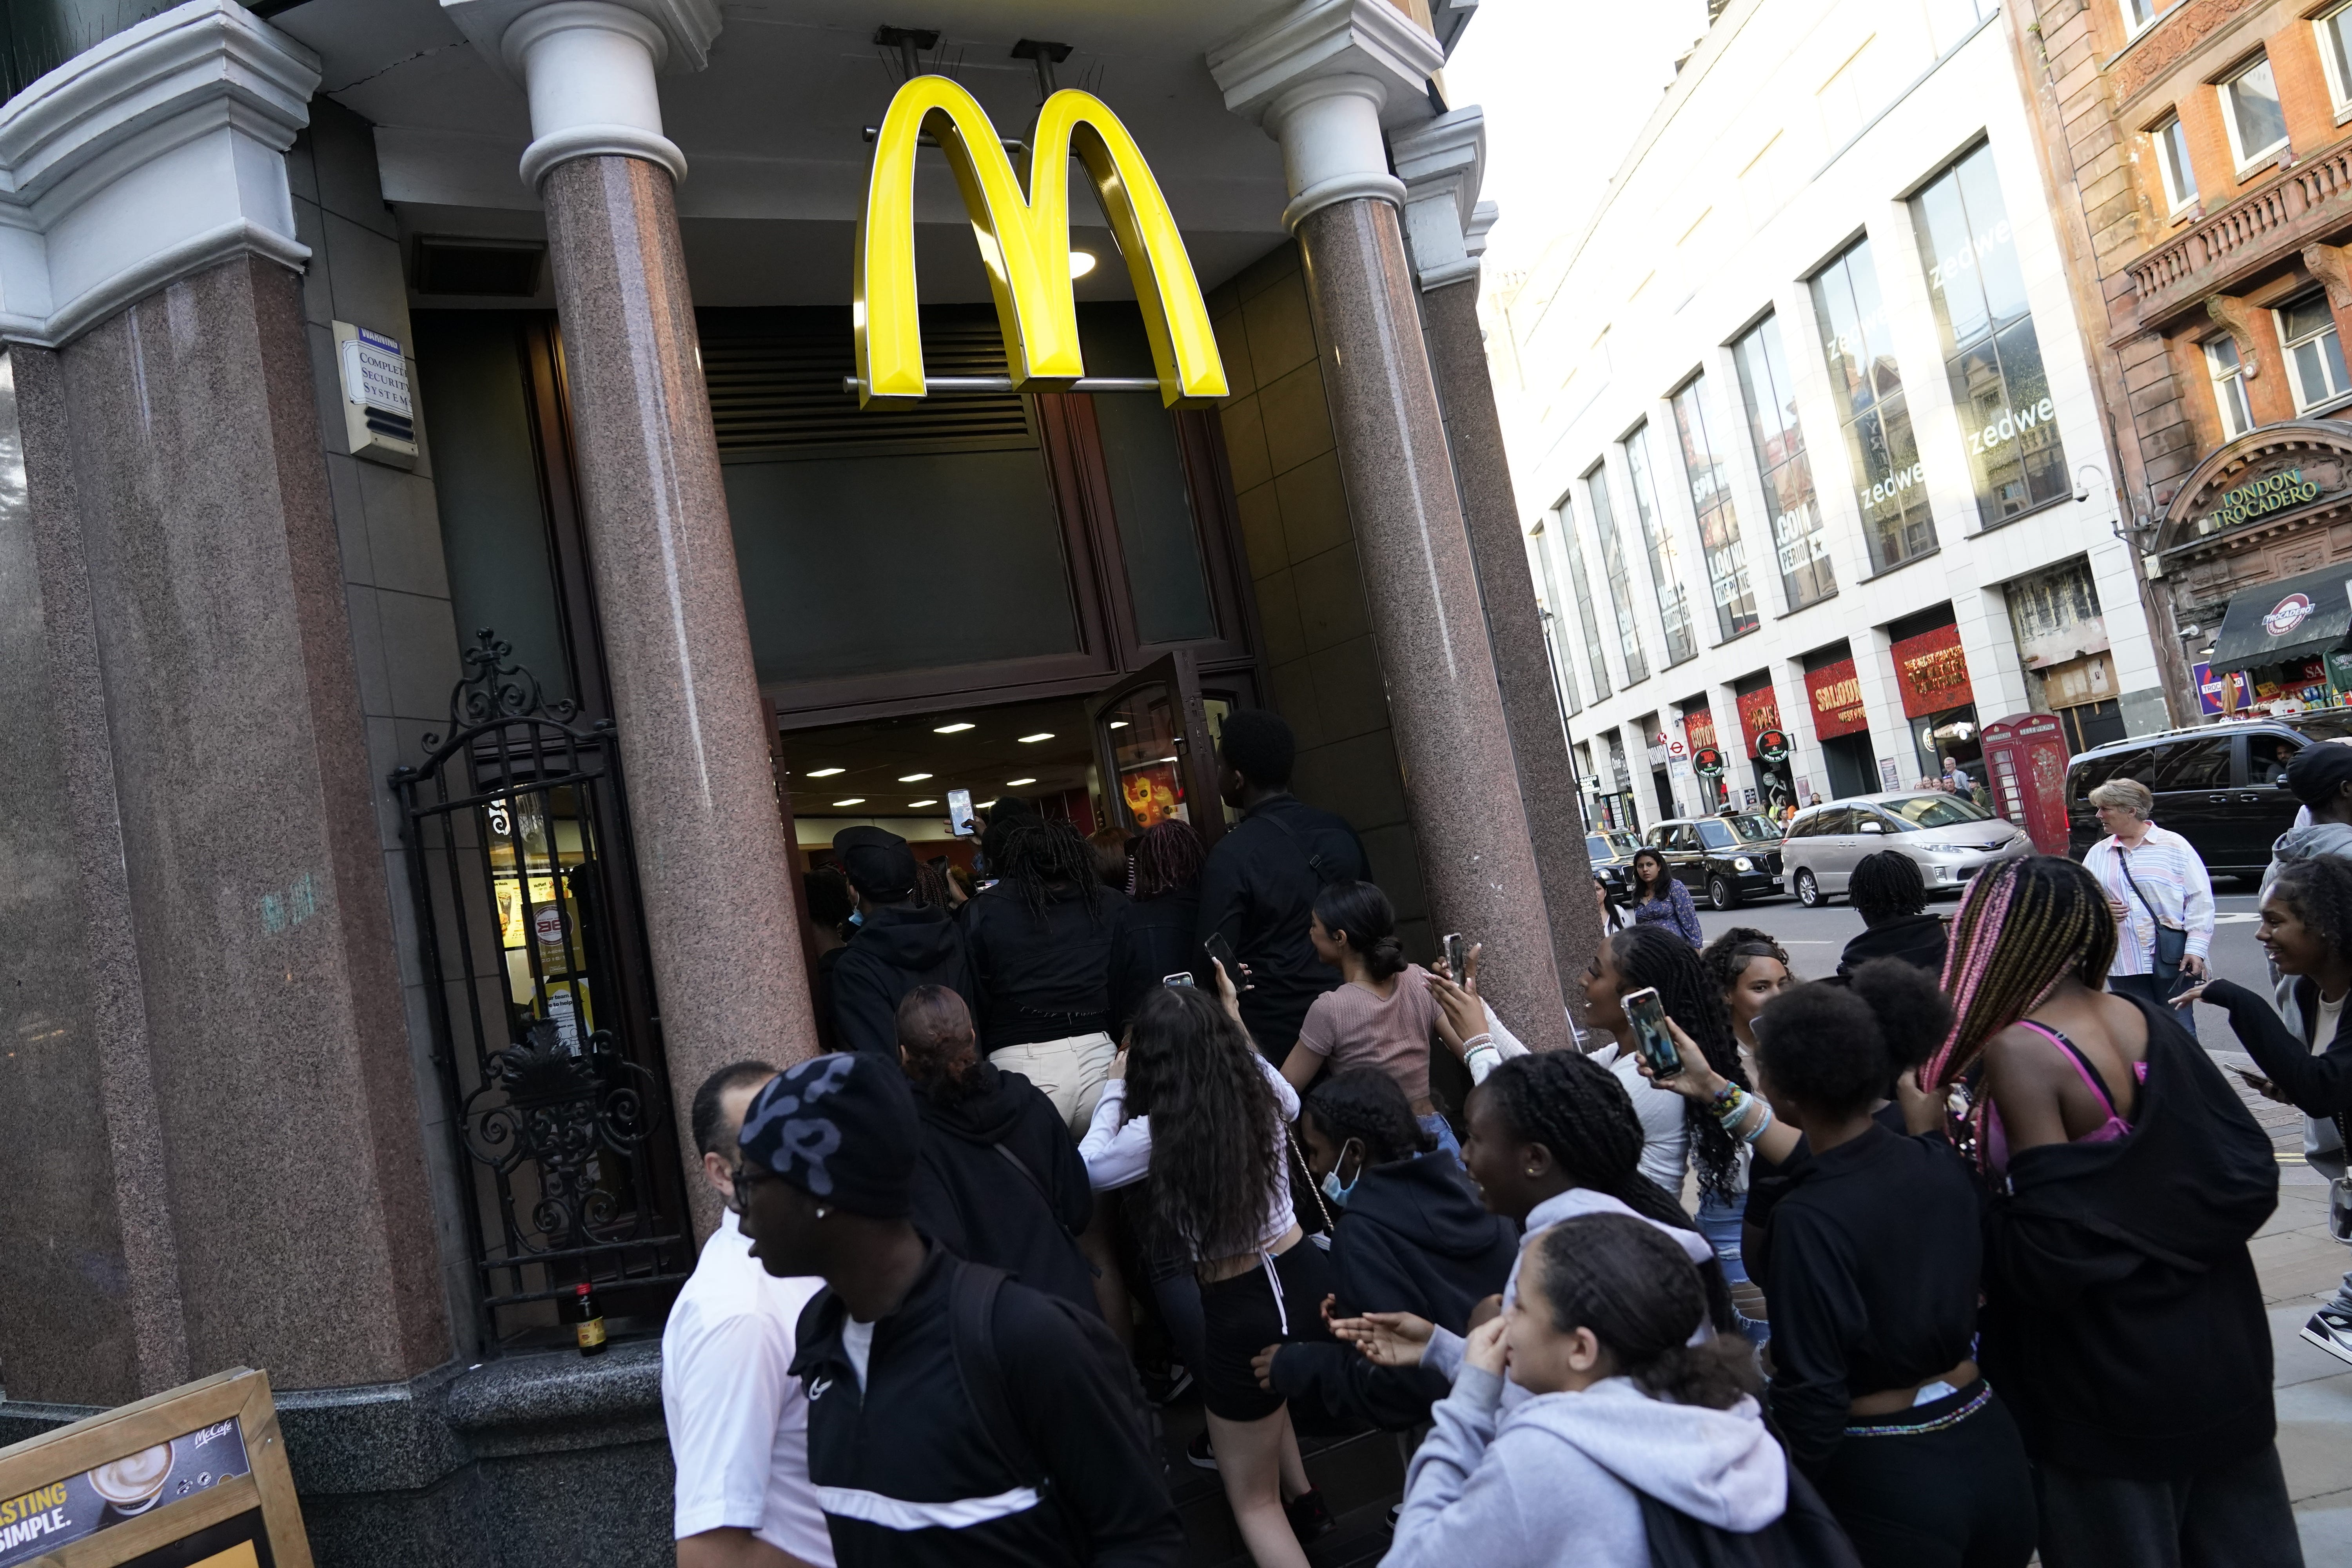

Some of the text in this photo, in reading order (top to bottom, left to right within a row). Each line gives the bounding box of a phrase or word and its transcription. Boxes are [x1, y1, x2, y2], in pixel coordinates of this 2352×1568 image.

[1968, 398, 2054, 456] zedwe
[1861, 462, 1924, 510] zedwe
[2222, 468, 2300, 508] LONDON
[2209, 481, 2317, 528] TROCADERO
[2265, 606, 2312, 623] TROCADERO
[2203, 679, 2241, 693] TROCRO
[2305, 665, 2325, 679] SA
[1815, 678, 1862, 712] SALOON
[2021, 723, 2054, 735] TELEPHONE
[1612, 757, 1622, 770] One
[195, 1420, 232, 1449] McCafé
[0, 1482, 67, 1526] STING
